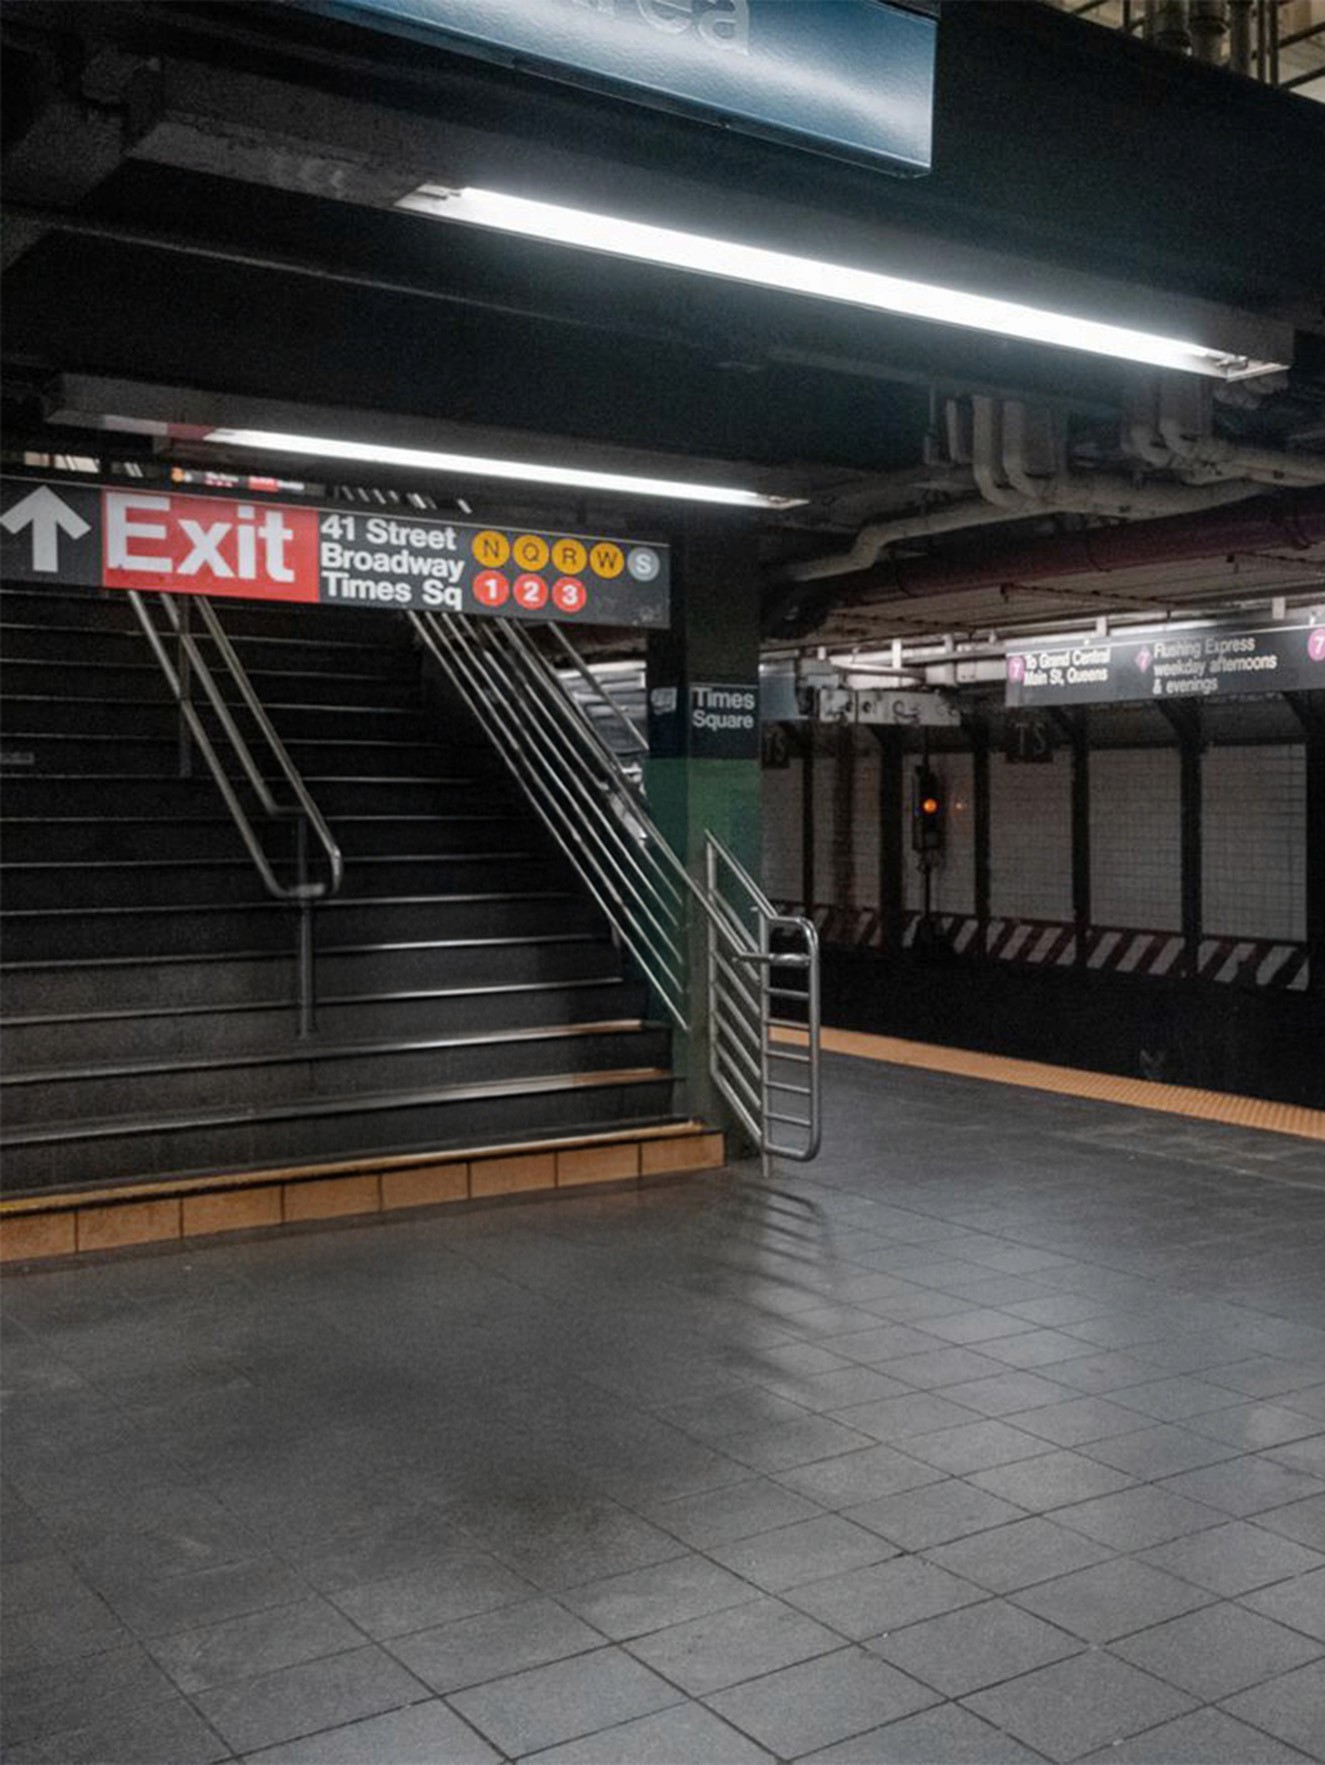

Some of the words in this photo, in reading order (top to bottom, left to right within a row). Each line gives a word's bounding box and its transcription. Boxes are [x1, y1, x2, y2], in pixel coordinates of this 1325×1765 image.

[105, 491, 295, 583] Exit
[320, 514, 356, 541] 41
[366, 518, 457, 550] Street
[320, 542, 465, 583] Broadway
[482, 539, 500, 559] N
[522, 542, 541, 563] Q
[597, 549, 617, 570] W
[635, 553, 652, 573] S
[320, 571, 412, 601] Times
[422, 579, 463, 611] Sq
[522, 581, 539, 601] 2
[561, 584, 577, 605] 3
[1154, 641, 1201, 658] Flushing
[1205, 637, 1256, 654] Express
[1153, 659, 1206, 677] weekday
[1209, 655, 1277, 673] afternoons
[1152, 679, 1162, 695] &
[1166, 677, 1218, 694] evenings
[693, 688, 755, 710] Times
[693, 710, 754, 731] Square
